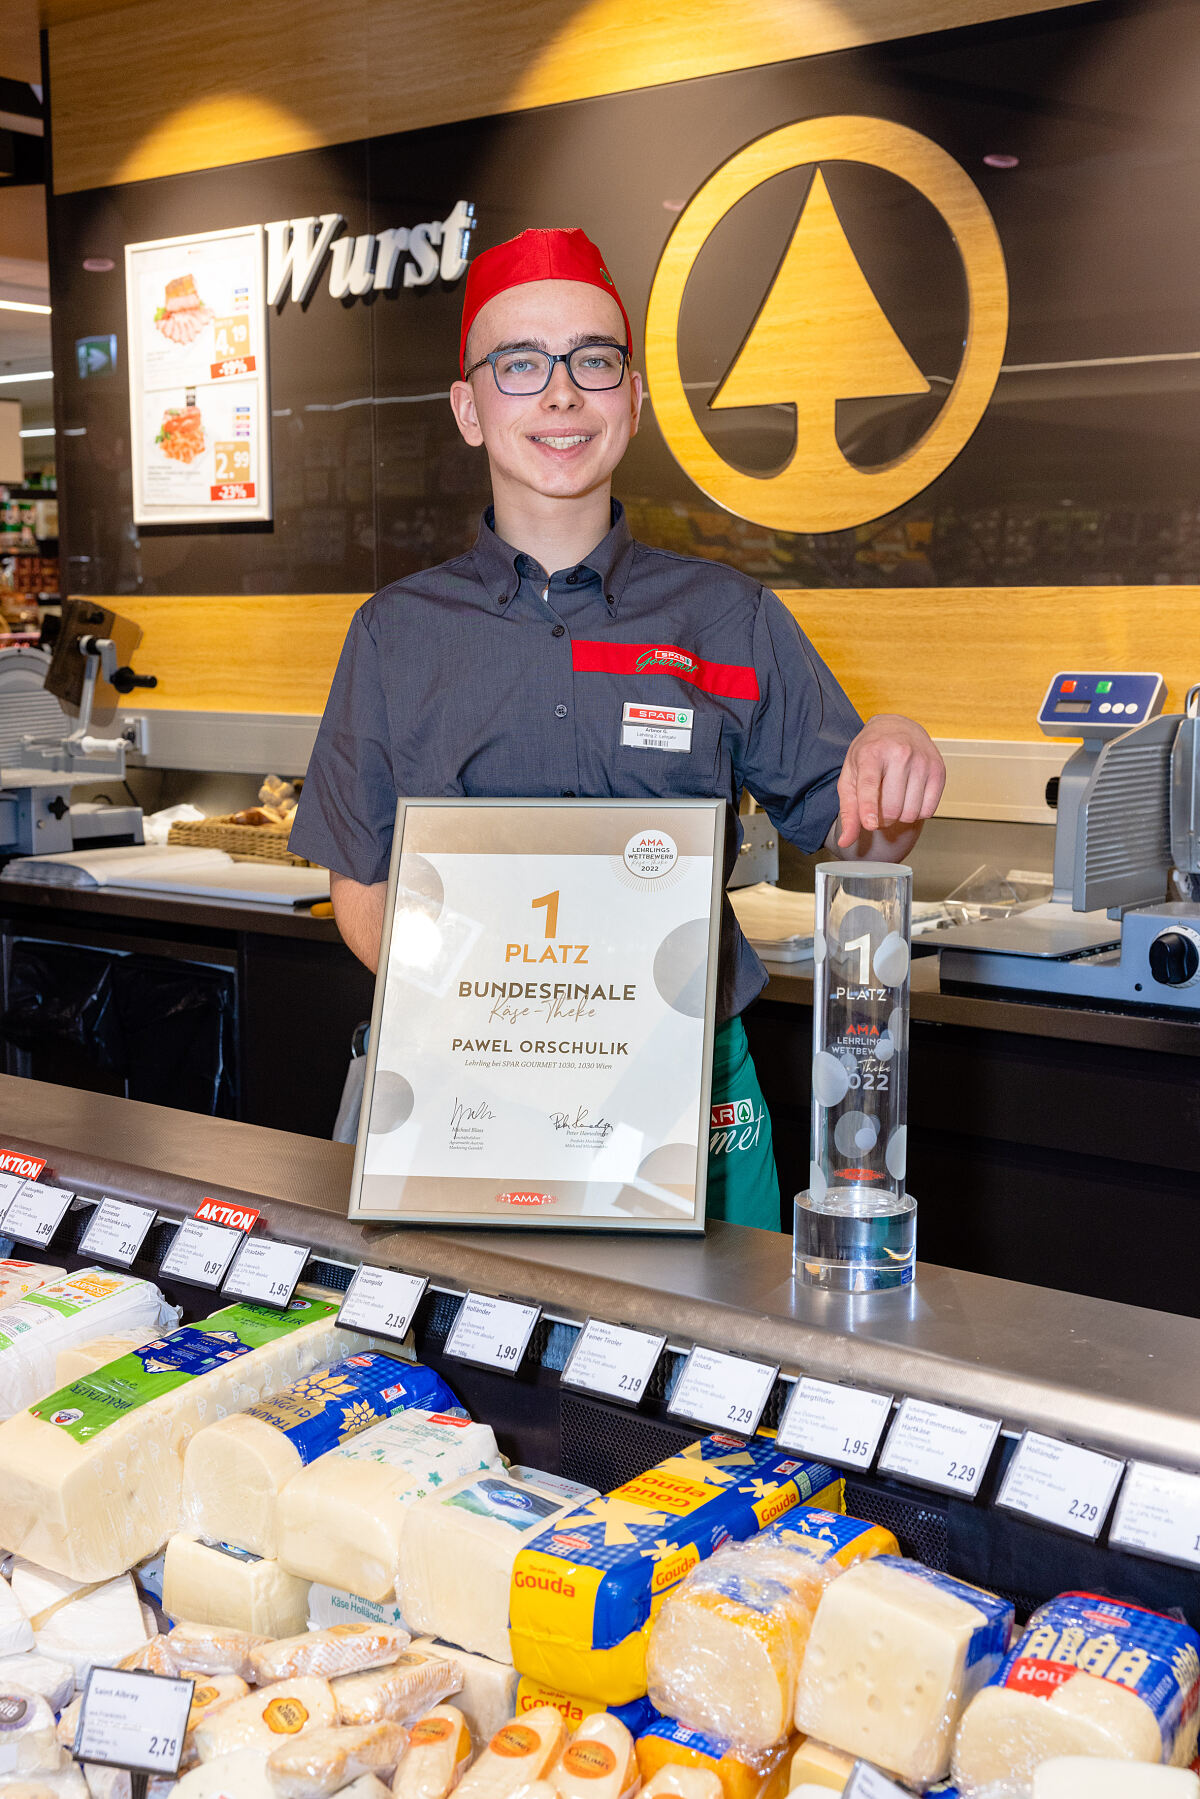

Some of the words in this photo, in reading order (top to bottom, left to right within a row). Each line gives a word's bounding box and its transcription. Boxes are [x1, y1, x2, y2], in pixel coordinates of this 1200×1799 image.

[264, 200, 473, 306] Wurst
[636, 648, 699, 673] Gourmet
[661, 652, 685, 662] SPAR
[639, 710, 675, 722] SPAR
[531, 889, 560, 939] 1
[504, 944, 589, 964] PLATZ
[844, 933, 871, 985] 1
[458, 981, 637, 1001] BUNDESFINALE
[836, 987, 888, 1002] PLATZ
[846, 1023, 880, 1036] AMA
[452, 1038, 513, 1053] PAWEL
[519, 1040, 629, 1055] ORSCHULIK
[831, 1046, 875, 1055] WETTBEW
[464, 1059, 491, 1068] Lehrling
[502, 1060, 520, 1068] SPAR
[520, 1061, 557, 1069] GOURMET
[558, 1062, 577, 1070] 1030,
[596, 1062, 613, 1070] Wien
[848, 1073, 889, 1091] 022
[0, 1153, 42, 1178] AKTION
[512, 1194, 540, 1203] AMA
[197, 1203, 255, 1230] AKTION
[35, 1222, 53, 1236] 1,99
[118, 1241, 138, 1256] 2,19
[203, 1260, 223, 1275] 0,97
[269, 1281, 290, 1297] 1,95
[384, 1313, 406, 1329] 2,19
[495, 1344, 518, 1360] 1,99
[692, 1361, 712, 1371] Gouda
[618, 1374, 642, 1392] 2,19
[727, 1405, 753, 1424] 2,29
[842, 1437, 869, 1456] 1,95
[947, 1461, 976, 1482] 2,29
[760, 1492, 797, 1523] Gouda
[1068, 1499, 1098, 1521] 2,29
[655, 1556, 697, 1587] Gouda
[514, 1571, 576, 1598] Gouda
[148, 1736, 177, 1758] 2,79
